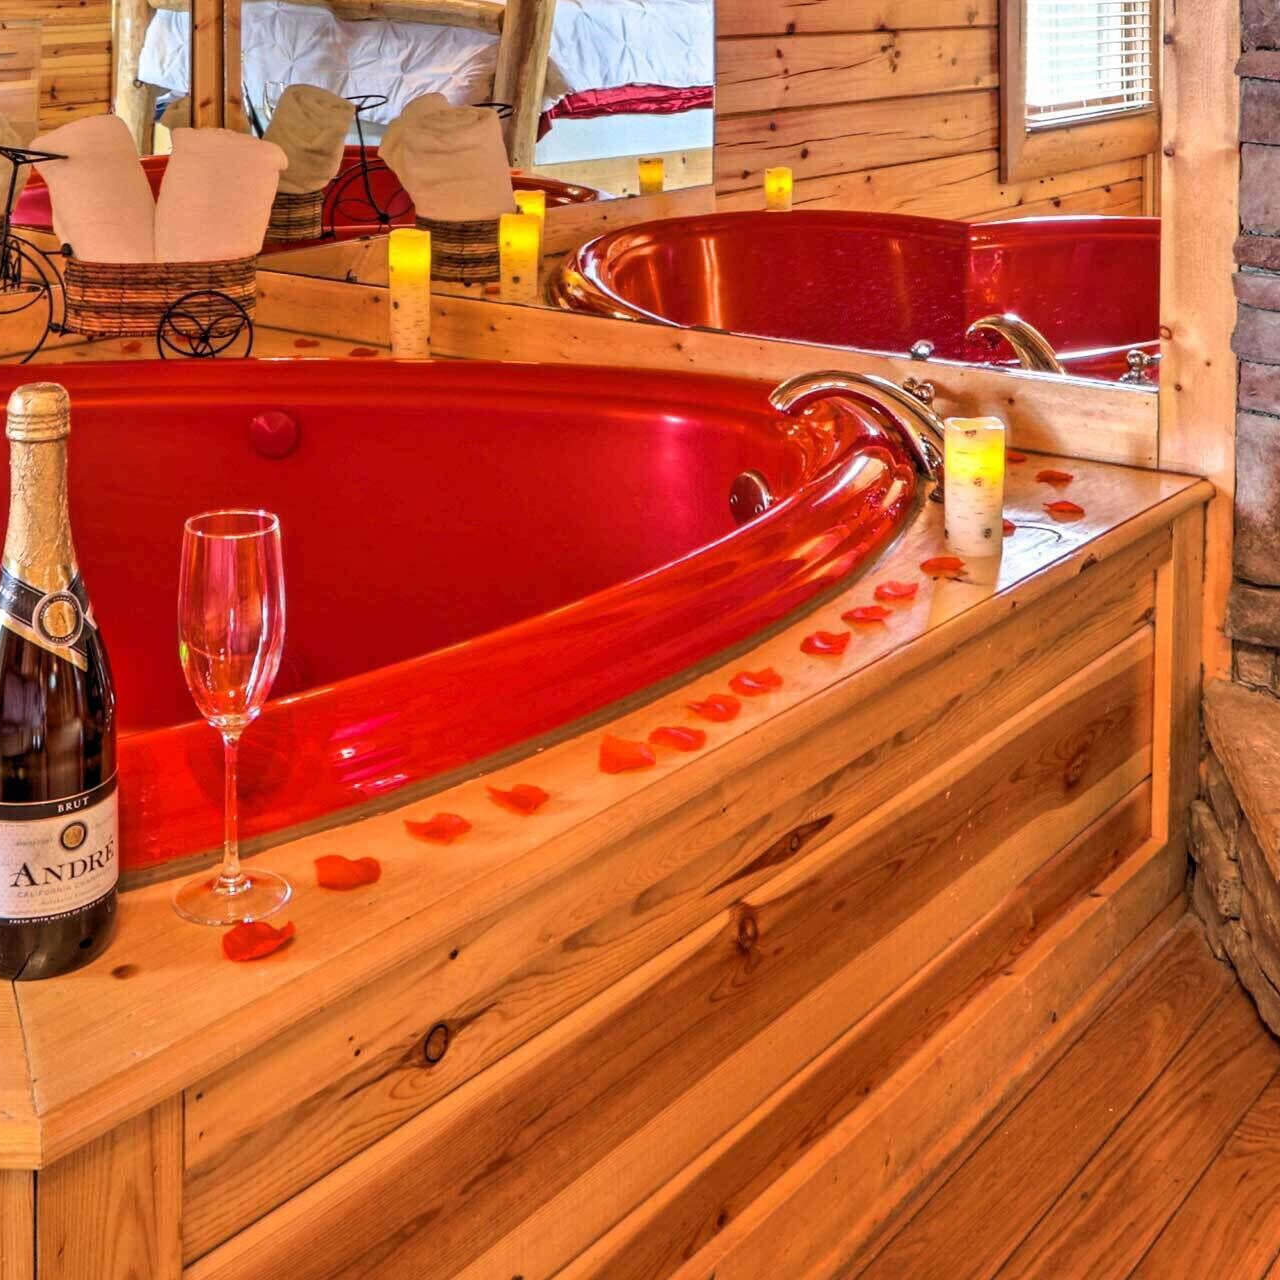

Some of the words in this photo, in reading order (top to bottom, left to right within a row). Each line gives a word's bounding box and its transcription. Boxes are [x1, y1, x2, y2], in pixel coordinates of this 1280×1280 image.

[57, 796, 89, 813] BRUT
[9, 835, 115, 888] ANDRÉ
[17, 885, 72, 898] CALIFORNIA
